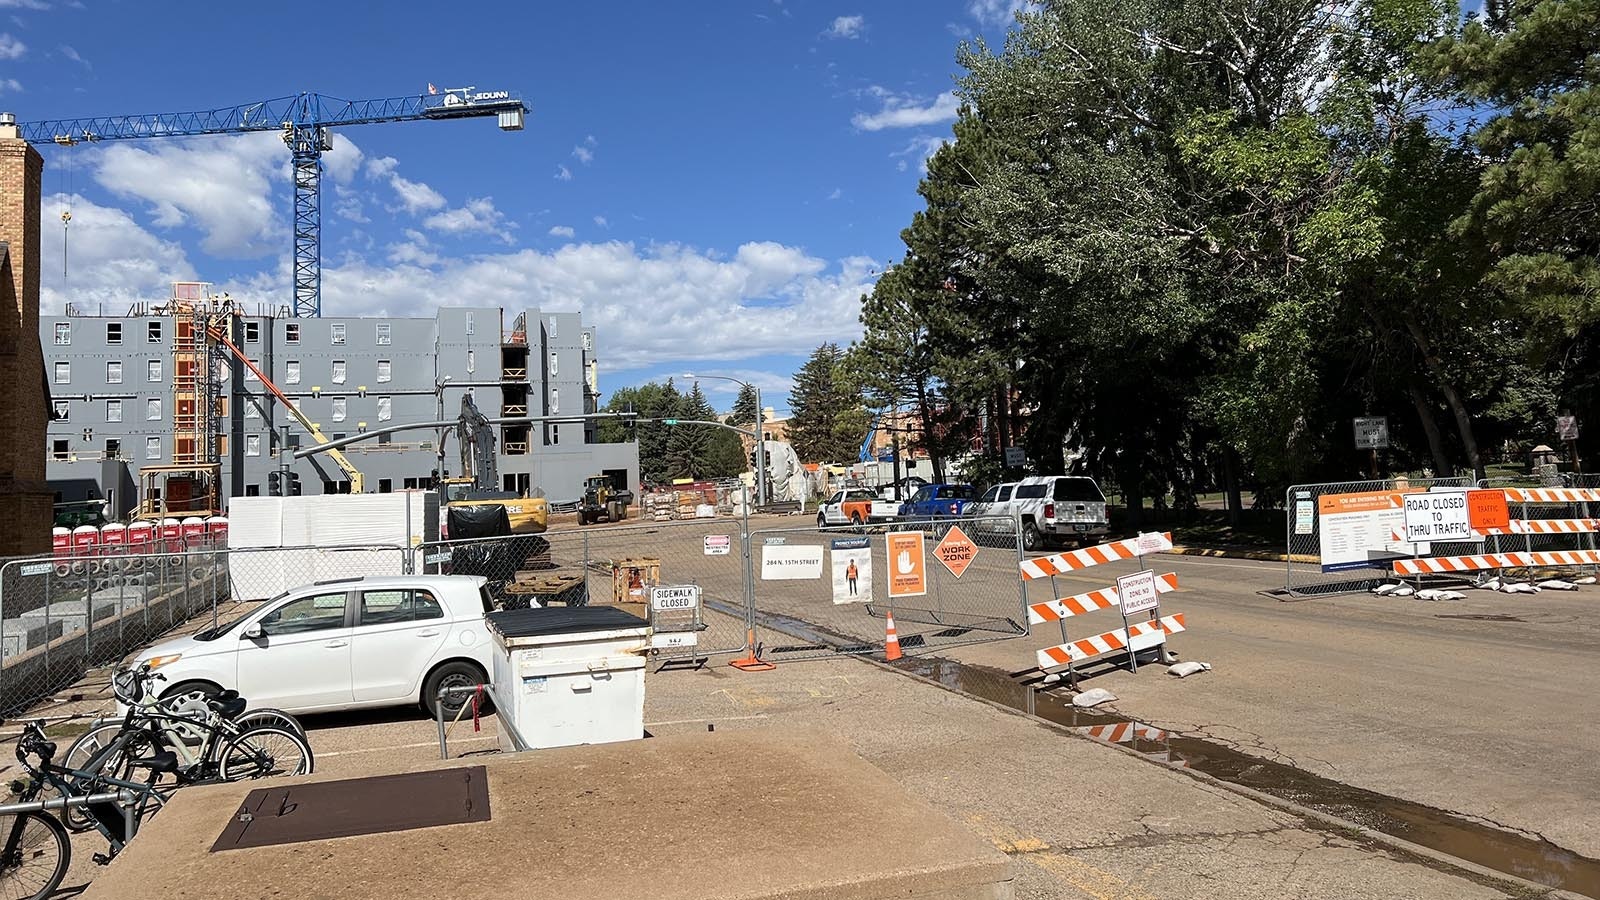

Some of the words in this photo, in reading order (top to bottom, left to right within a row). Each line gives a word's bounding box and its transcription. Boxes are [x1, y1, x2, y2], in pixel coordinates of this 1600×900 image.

[1469, 493, 1503, 501] CONSTRUCTION
[1407, 499, 1429, 511] ROAD
[1433, 498, 1464, 510] CLOSED
[1478, 505, 1499, 513] TRAFFIC
[1432, 512, 1443, 521] TO
[1409, 524, 1431, 536] THRU
[1434, 522, 1467, 535] TRAFFIC
[941, 546, 971, 554] WORK
[1123, 577, 1151, 588] CONSTRUCTION
[656, 589, 692, 598] SIDEWALK
[660, 599, 689, 607] CLOSED
[1126, 600, 1140, 608] PUBLIC
